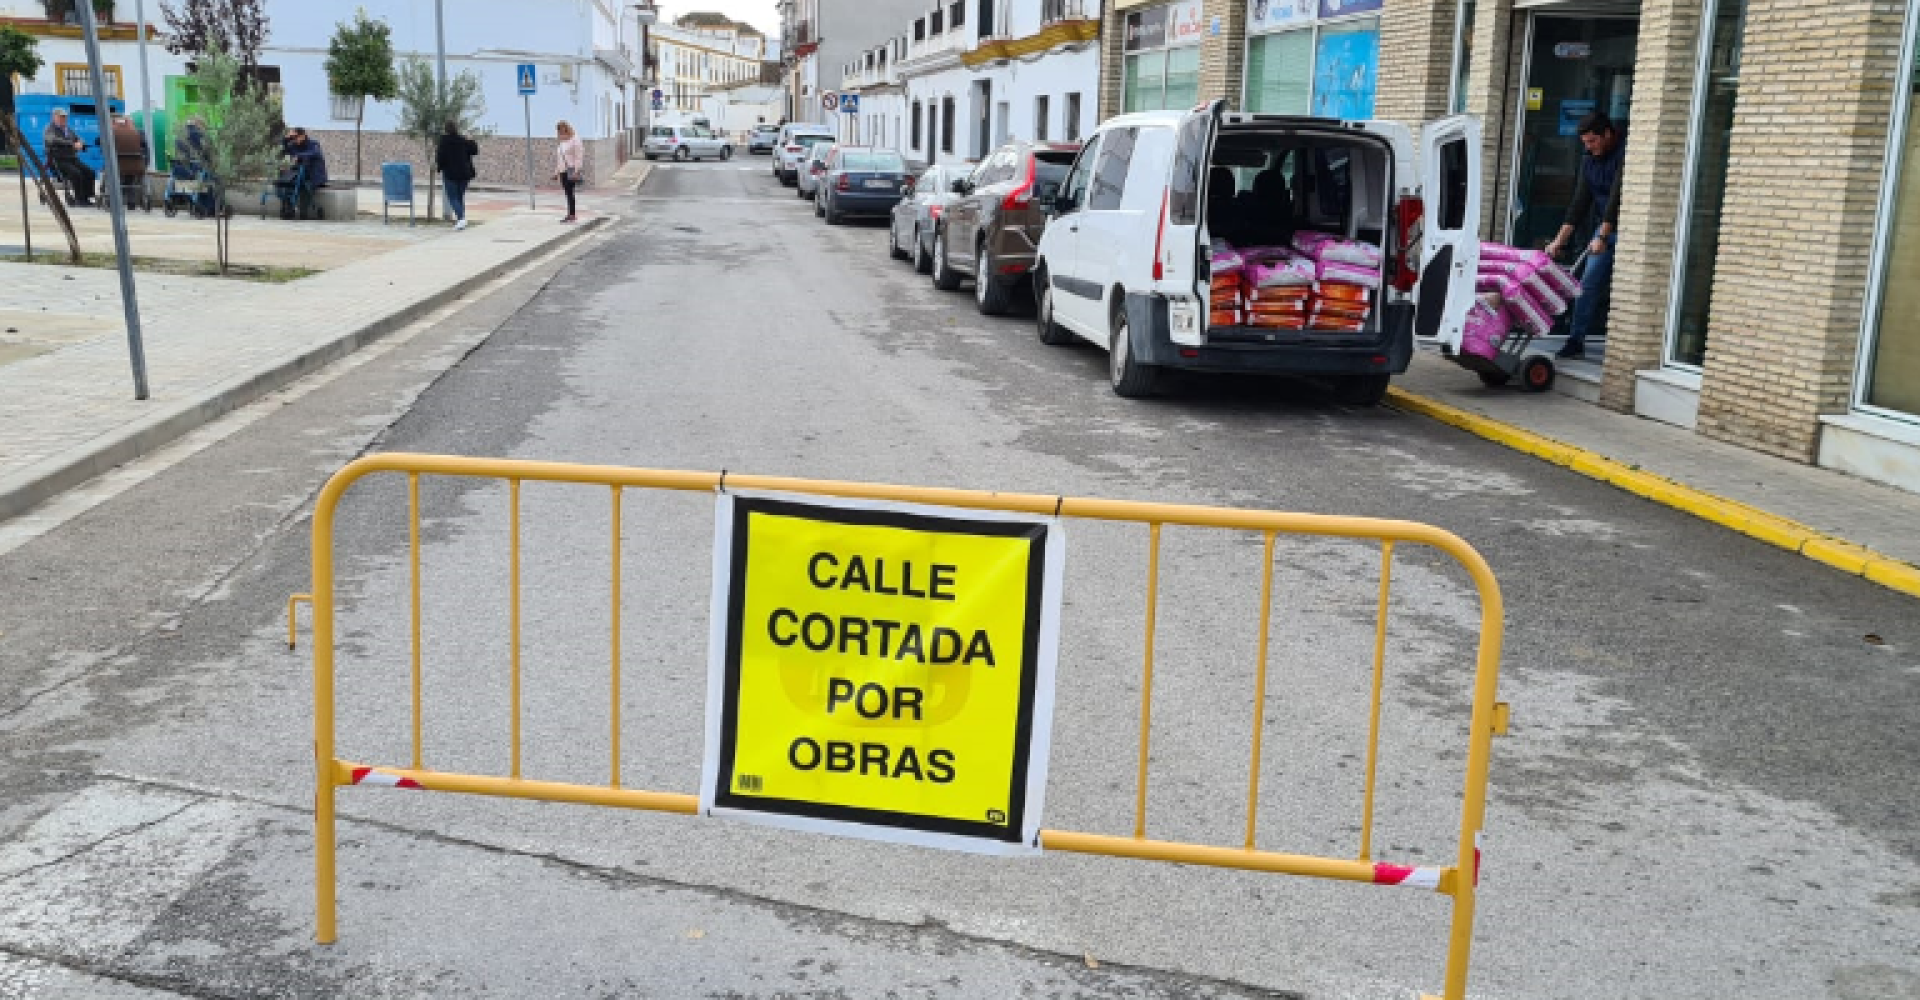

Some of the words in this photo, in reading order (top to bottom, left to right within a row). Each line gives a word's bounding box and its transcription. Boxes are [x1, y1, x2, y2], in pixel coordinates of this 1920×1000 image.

[808, 552, 956, 601] CALLE
[768, 608, 995, 666] CORTADA
[827, 677, 923, 720] POR
[789, 737, 956, 784] OBRAS
